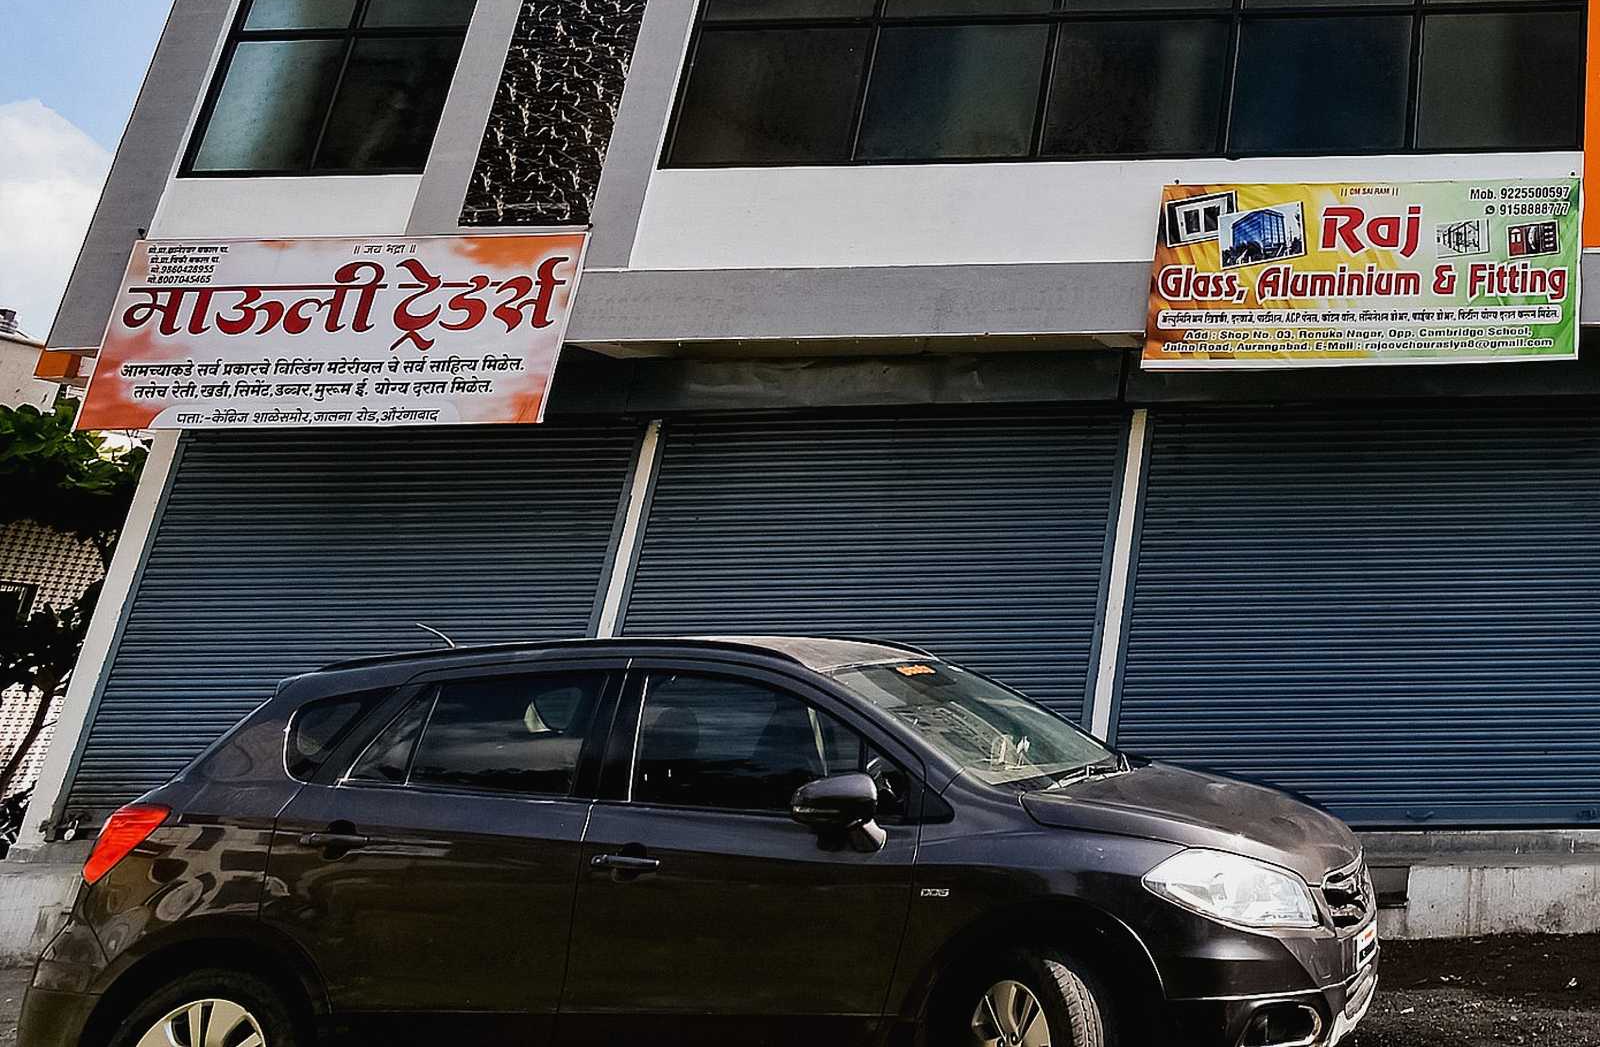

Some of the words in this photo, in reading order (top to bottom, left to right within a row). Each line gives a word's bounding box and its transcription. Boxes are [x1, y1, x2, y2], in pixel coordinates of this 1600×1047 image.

[1470, 189, 1496, 199] Mob.
[1501, 187, 1569, 199] 9225500597
[1321, 206, 1421, 258] Raj
[364, 245, 383, 254] जय
[1161, 267, 1246, 301] Glass,
[1258, 266, 1420, 301] Aluminium
[1433, 265, 1456, 295] &
[1469, 263, 1566, 300] Fitting
[122, 261, 388, 335] माऊली
[390, 257, 569, 350] ट्रेडर्स
[1285, 312, 1300, 322] ACP
[1185, 330, 1208, 339] Add
[1219, 329, 1250, 341] Shop
[1253, 330, 1272, 339] No.
[1389, 329, 1415, 338] Opp.
[1419, 327, 1484, 338] Cambridge
[1199, 343, 1232, 352] Road,
[120, 360, 194, 377] आमच्याकडे
[198, 358, 222, 376] सर्व
[222, 358, 271, 376] प्रकारचे
[327, 357, 384, 374] मटेरीयल
[388, 356, 400, 373] चे
[403, 356, 428, 373] सर्व
[430, 355, 479, 375] साहित्य
[481, 354, 525, 371] मिळेल.
[133, 382, 169, 398] तसेच
[375, 378, 410, 395] योग्य
[413, 380, 447, 397] दरात
[449, 376, 493, 394] मिळेल.
